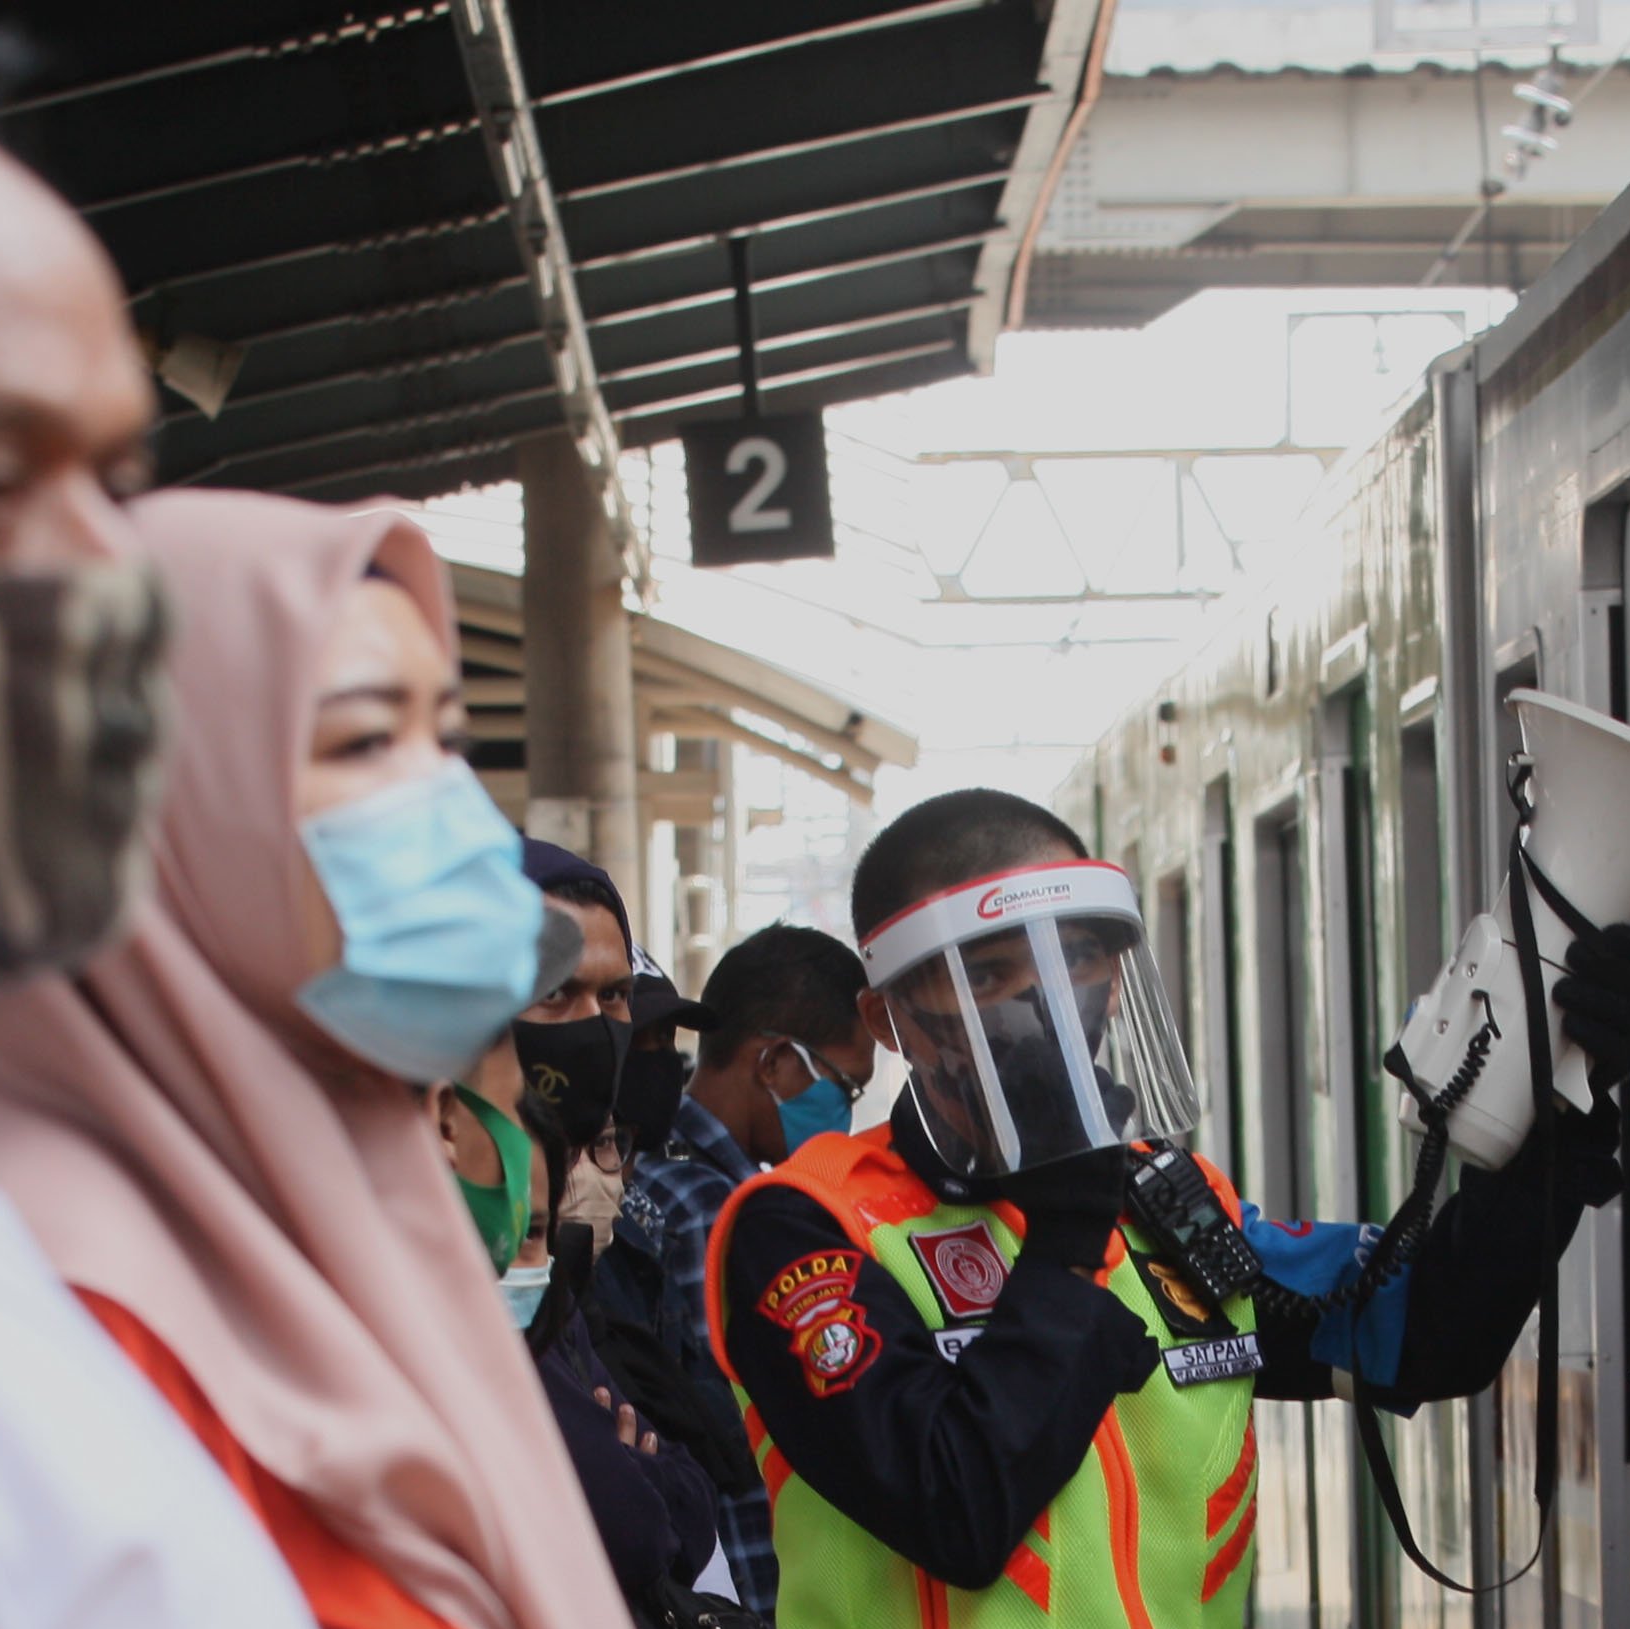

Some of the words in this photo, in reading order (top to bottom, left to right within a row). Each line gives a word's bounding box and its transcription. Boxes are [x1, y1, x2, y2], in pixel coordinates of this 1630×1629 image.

[725, 437, 792, 534] 2
[767, 1255, 848, 1309] POLDA
[1182, 1338, 1247, 1366] SATPAM
